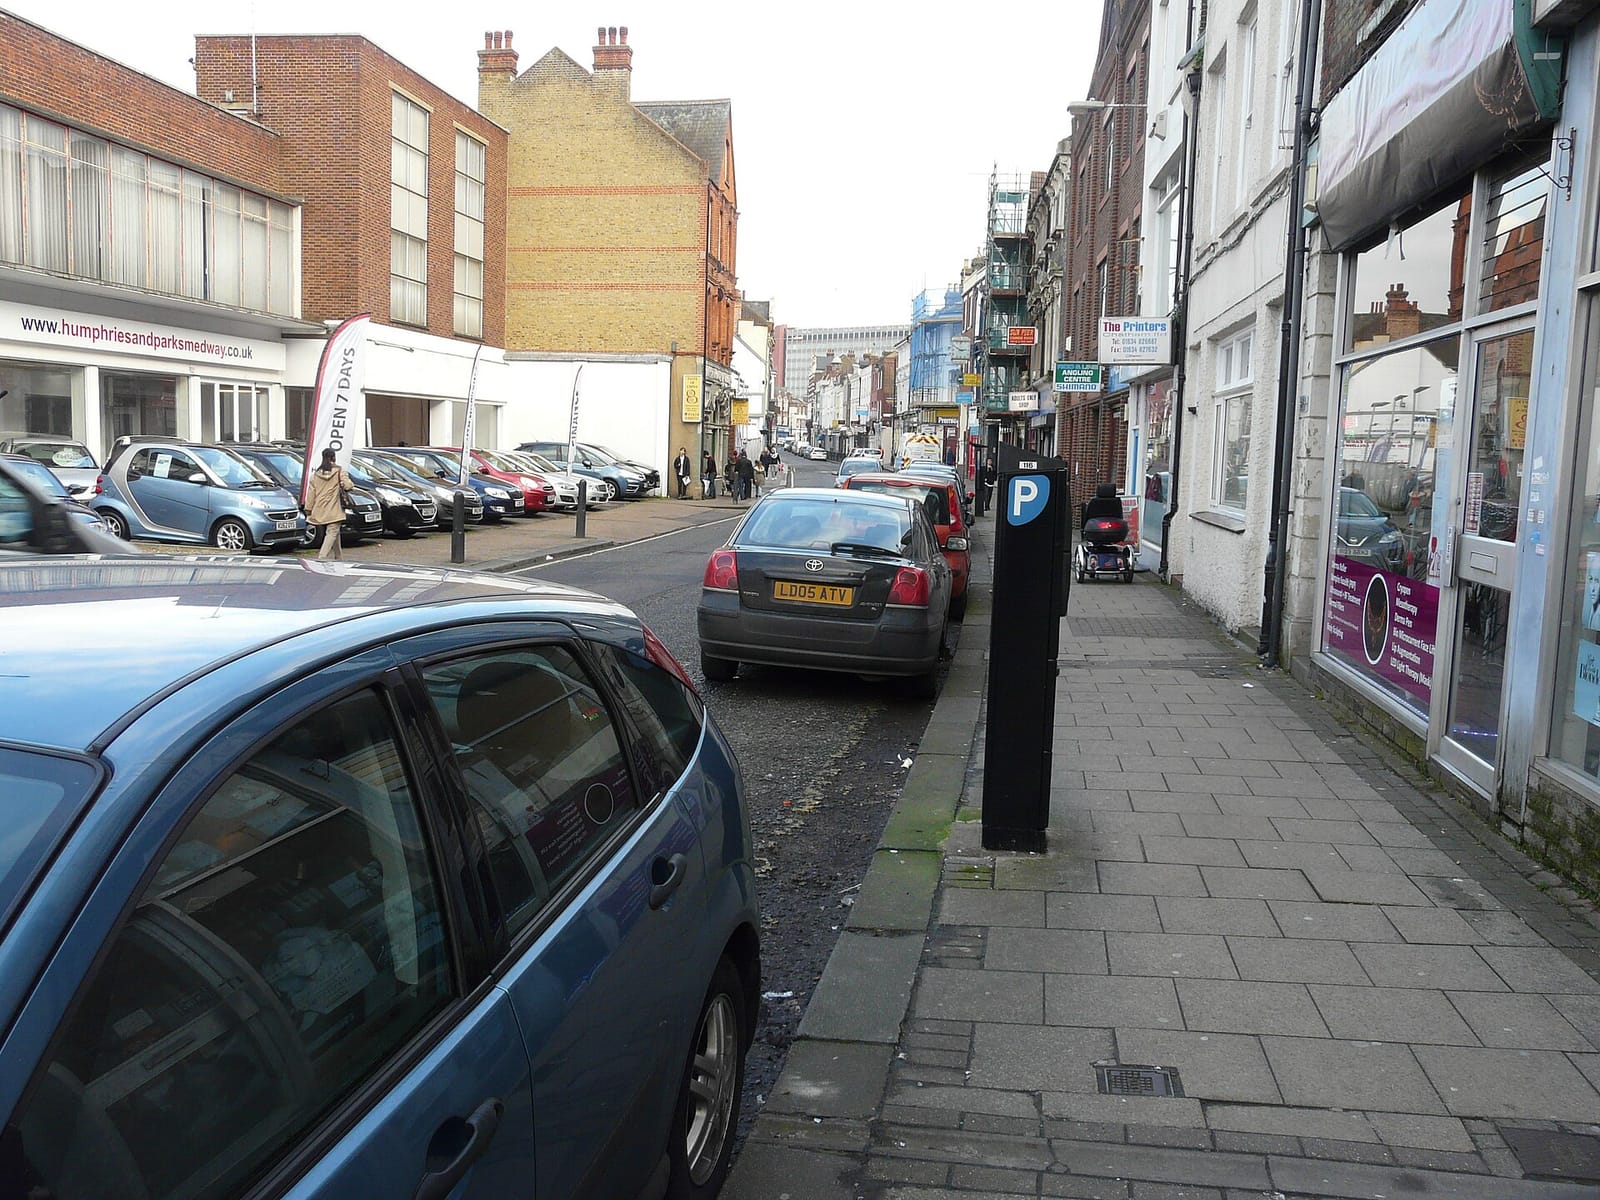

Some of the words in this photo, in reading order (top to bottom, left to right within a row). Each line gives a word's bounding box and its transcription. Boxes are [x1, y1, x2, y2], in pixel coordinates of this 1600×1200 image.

[21, 317, 253, 359] www.humphriesandparksmedway.co.uk
[1104, 322, 1120, 332] The
[1123, 322, 1167, 332] Printers
[338, 347, 355, 389] DAYS
[336, 394, 349, 403] 7
[329, 408, 347, 452] OPEN
[1013, 480, 1038, 516] P
[780, 583, 816, 598] LD05
[820, 586, 847, 602] ATV
